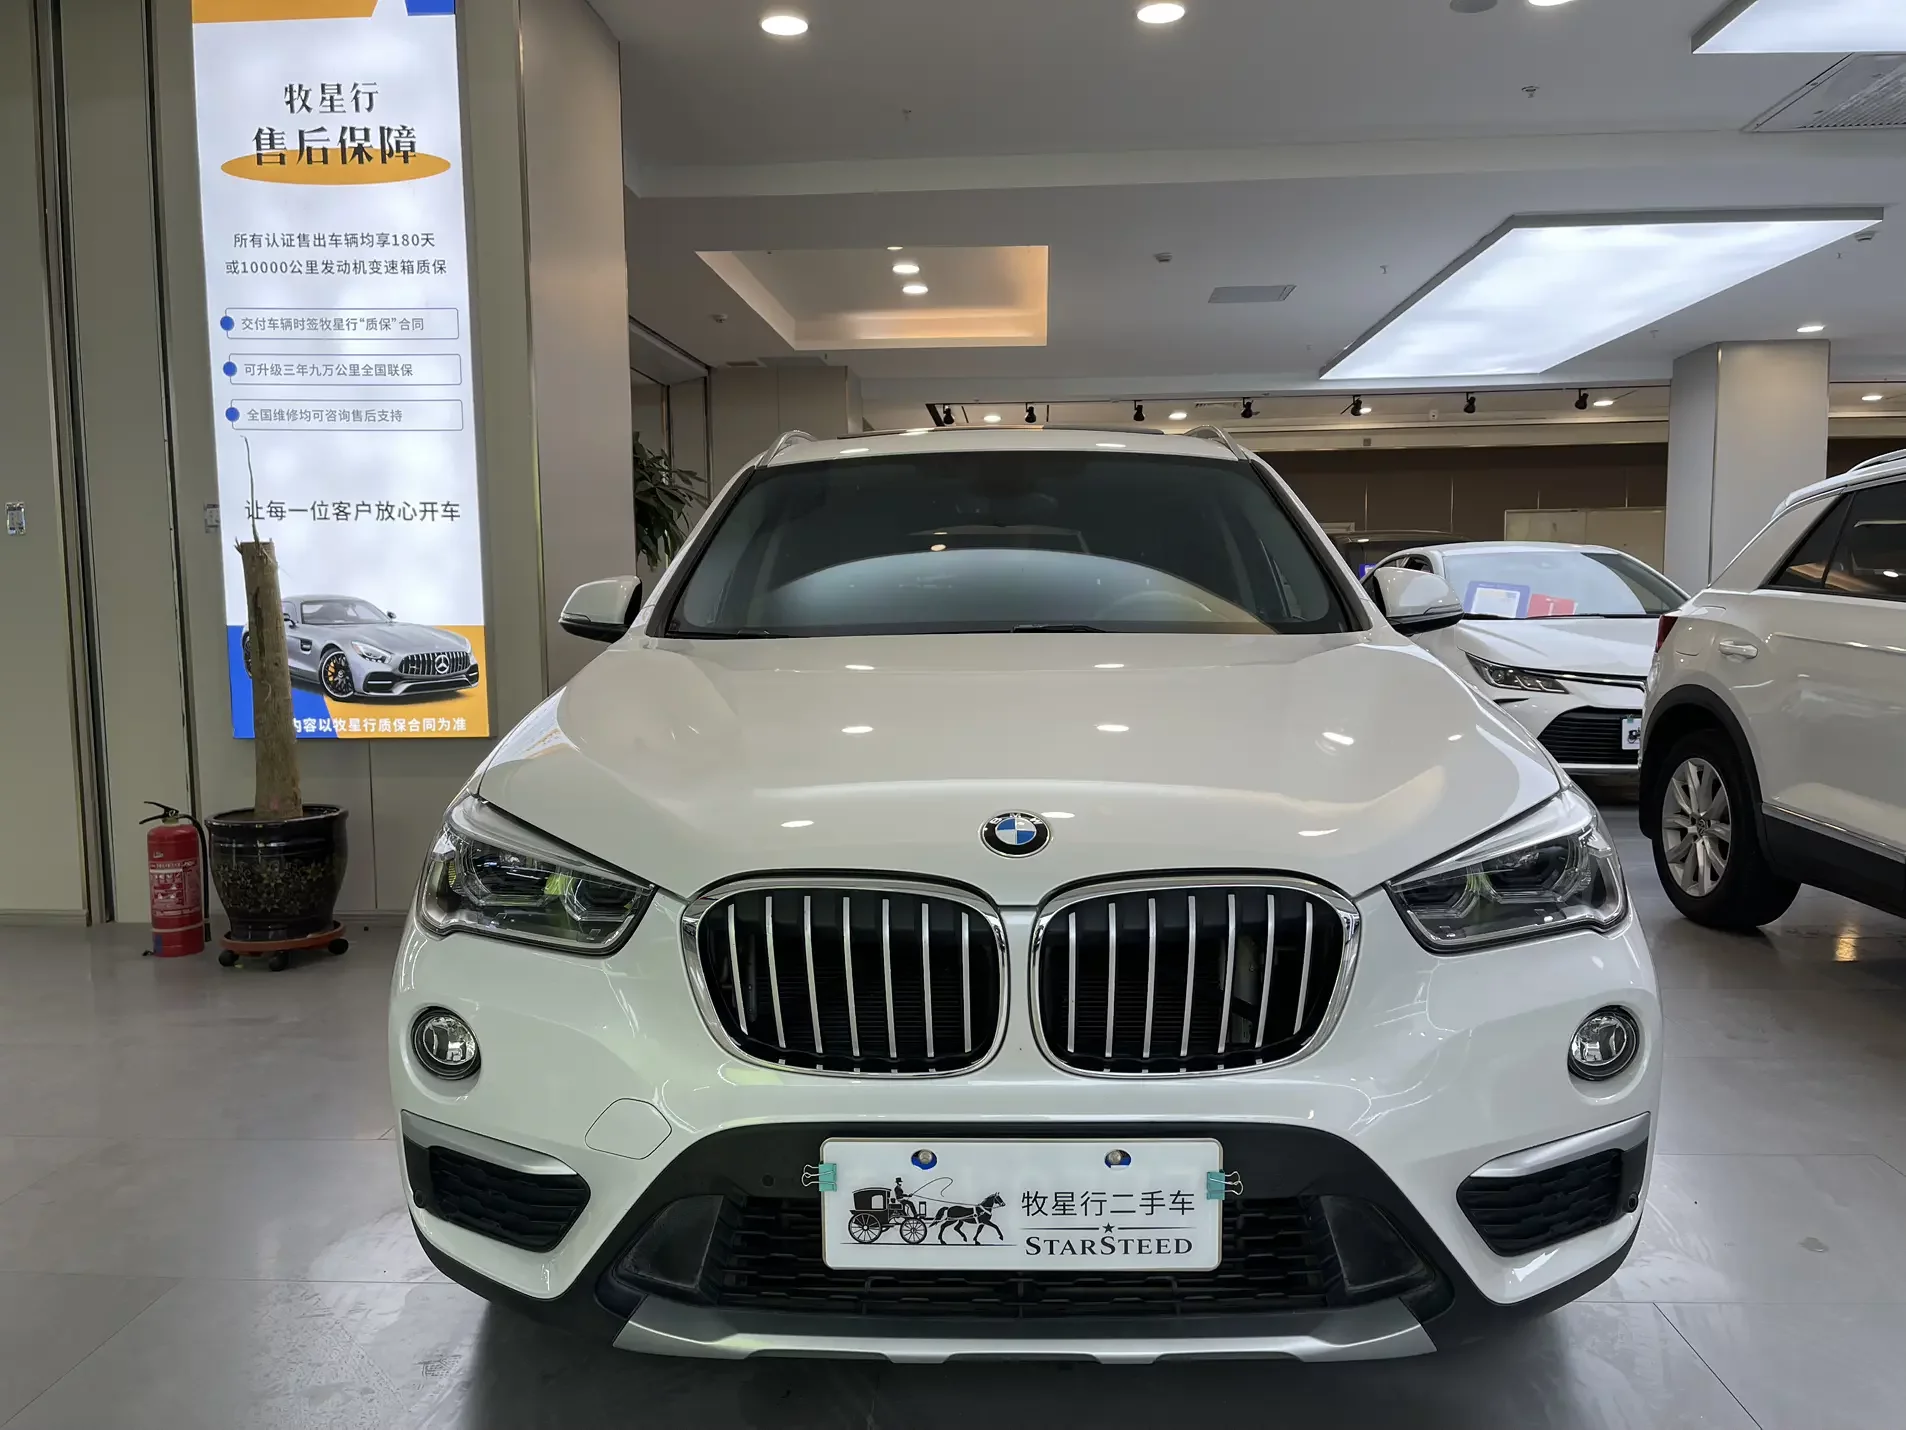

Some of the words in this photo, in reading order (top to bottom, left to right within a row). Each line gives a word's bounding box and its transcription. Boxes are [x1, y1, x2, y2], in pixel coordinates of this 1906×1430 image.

[283, 82, 379, 114] 牧星行
[252, 124, 418, 166] 售后保障
[233, 232, 436, 249] 所有认证售出车辆均享180天
[225, 259, 447, 275] 或10000公里发动机变速箱质保
[244, 363, 414, 378] 可升级三年九万公里全国联保
[247, 408, 403, 423] 全国维修均可咨询售后支持
[244, 499, 461, 522] 让每一位客户放心开车
[1021, 1189, 1195, 1217] 牧星行二手车
